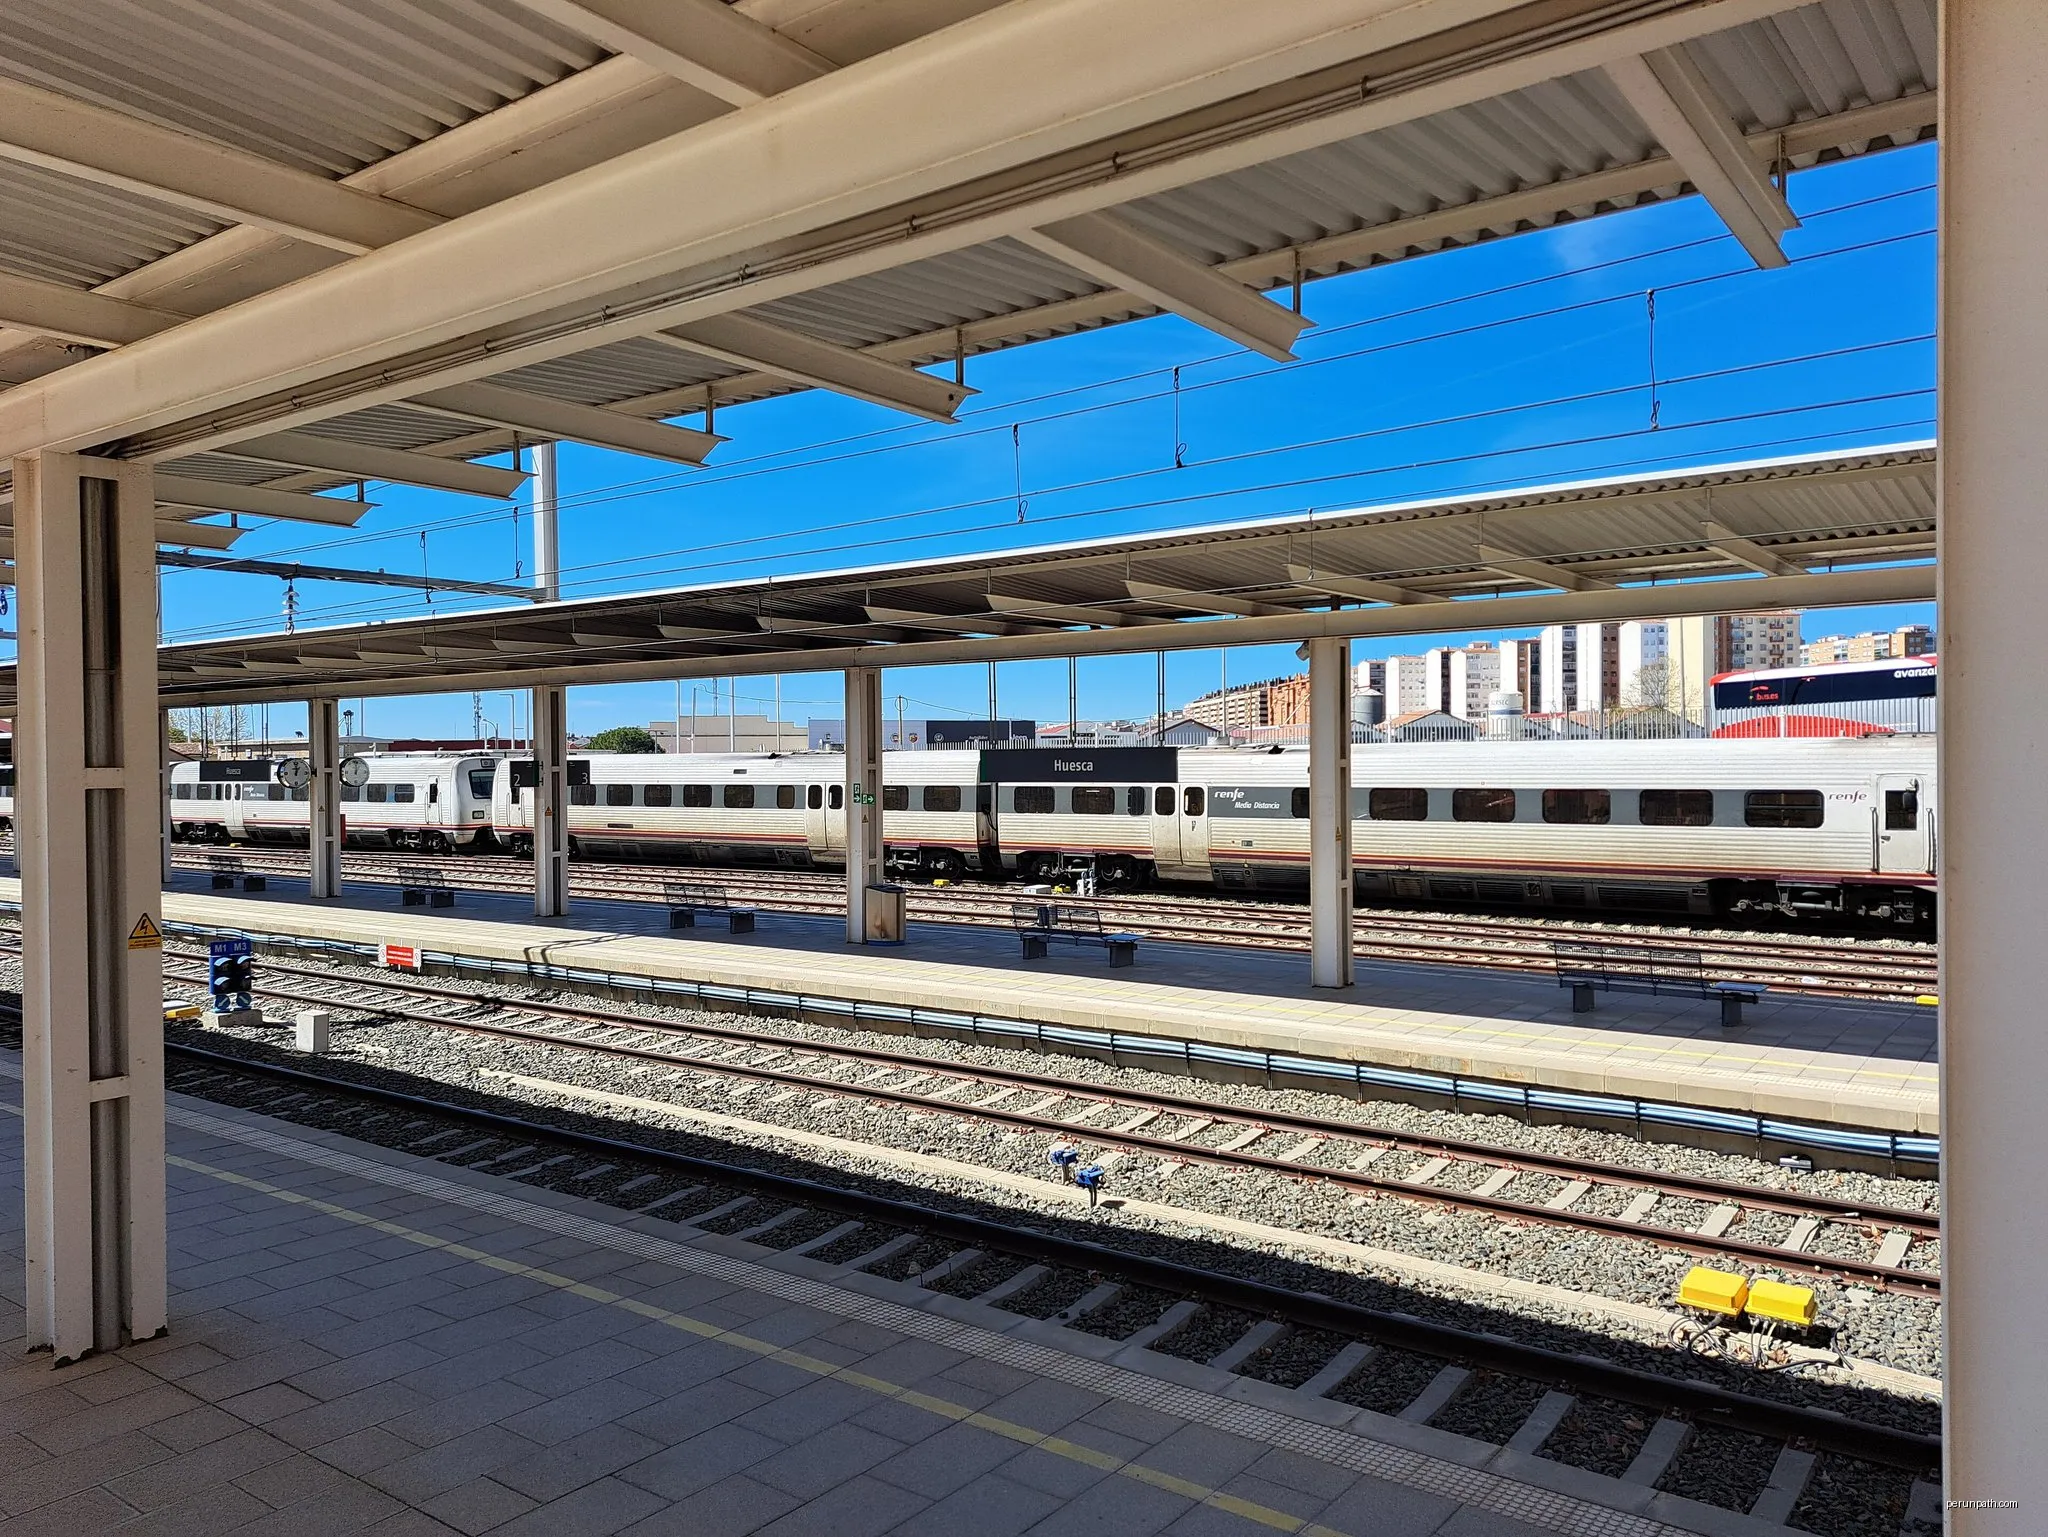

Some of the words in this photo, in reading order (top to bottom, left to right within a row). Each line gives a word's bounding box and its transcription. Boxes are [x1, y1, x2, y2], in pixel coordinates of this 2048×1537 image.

[1053, 759, 1094, 772] Huesca
[513, 773, 521, 787] 2
[581, 772, 589, 785] 3
[1214, 787, 1245, 802] renfe
[1829, 790, 1867, 803] renfe
[1234, 801, 1252, 809] Media
[1253, 801, 1281, 810] Distancia
[214, 944, 227, 953] M1
[233, 942, 247, 952] M3
